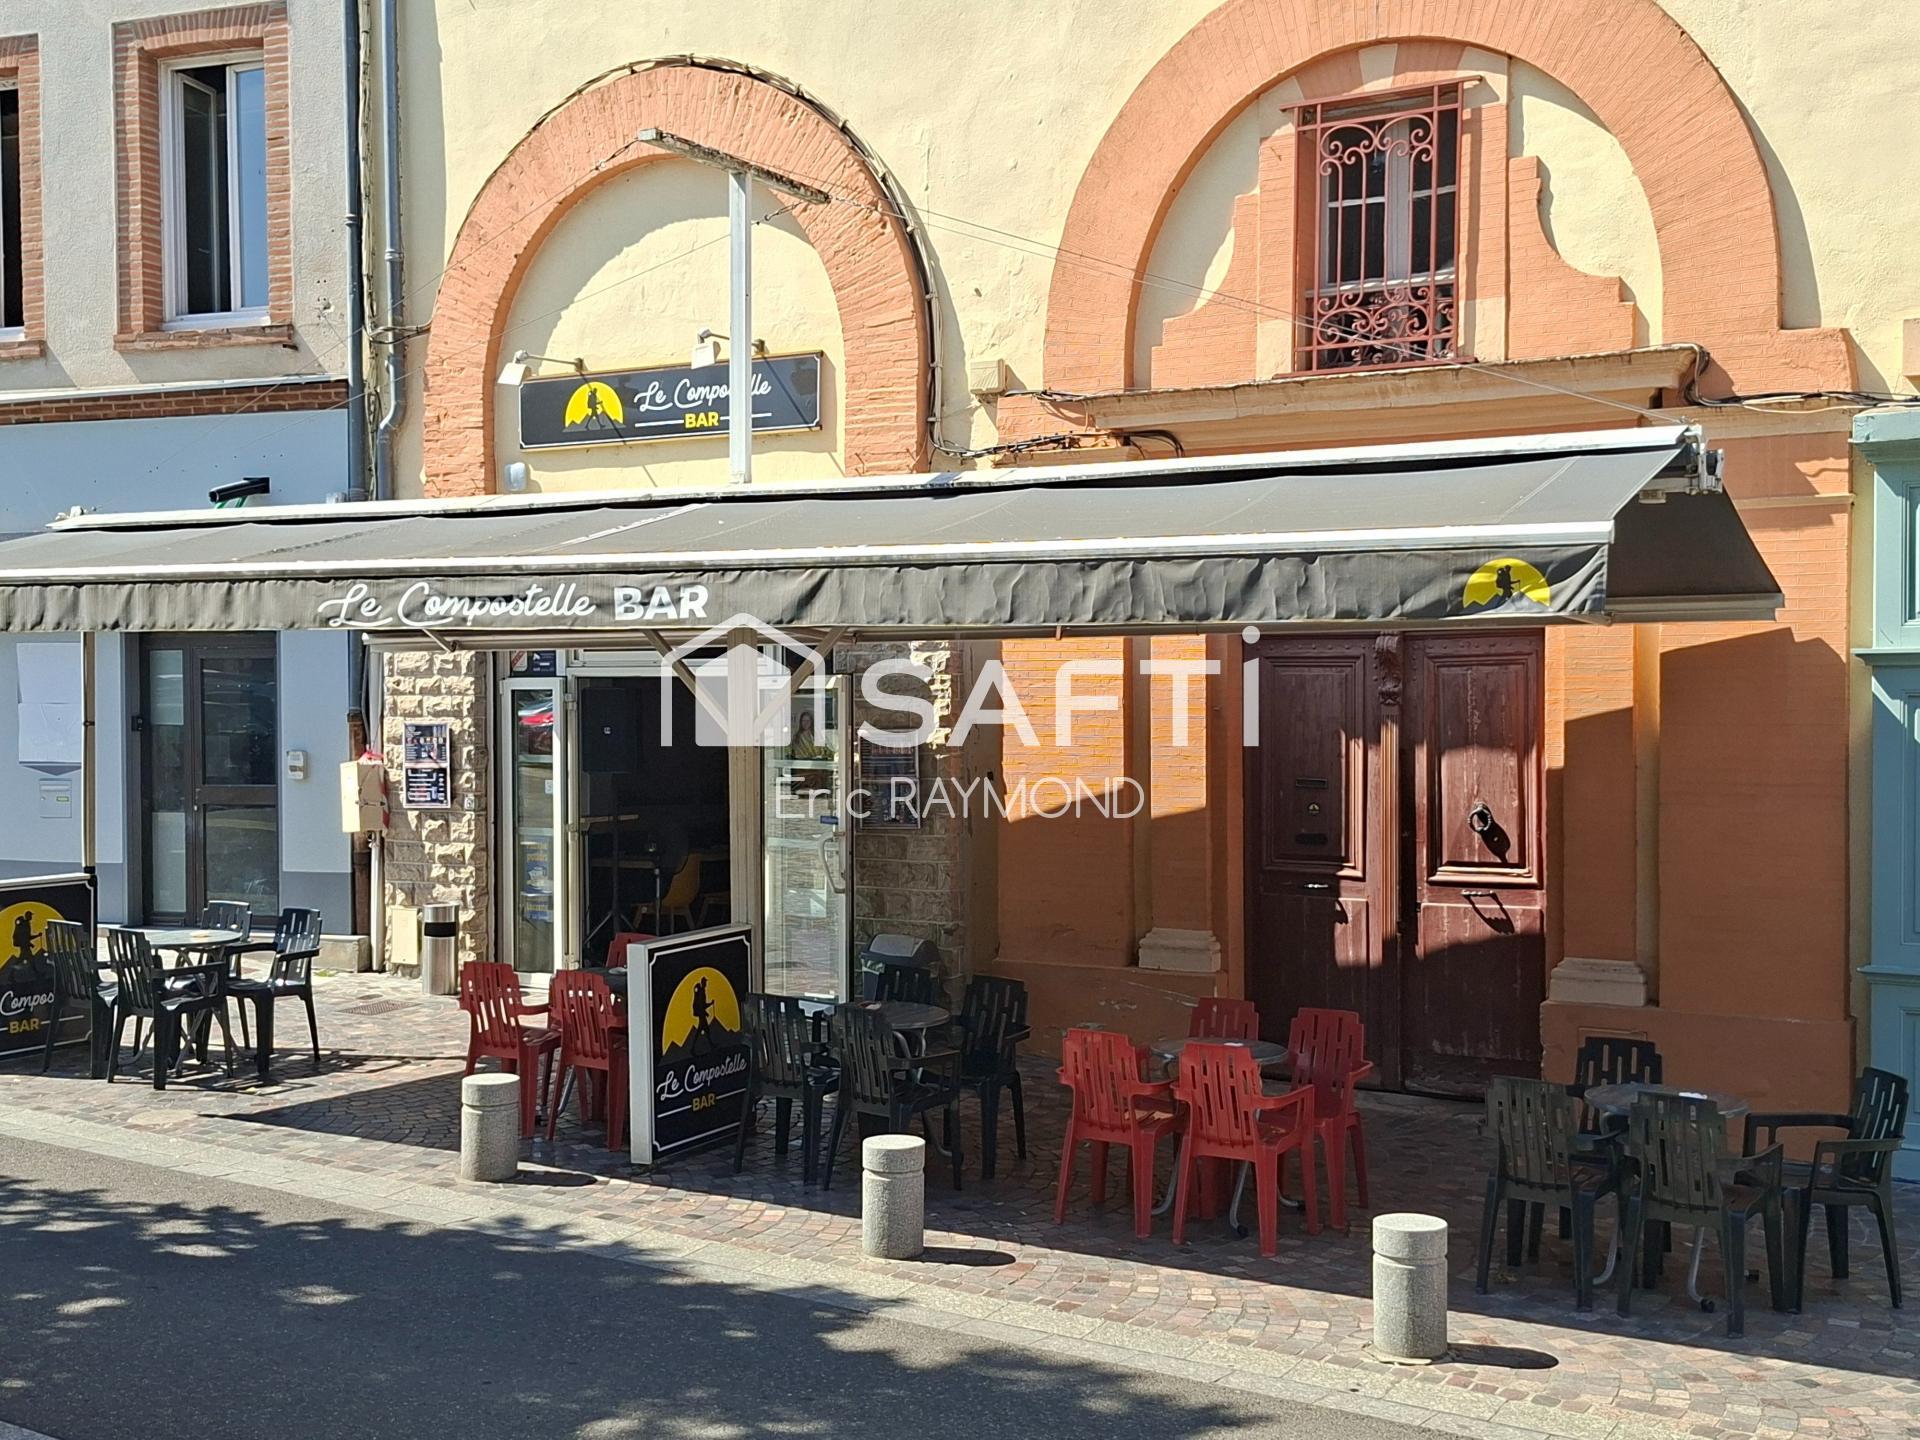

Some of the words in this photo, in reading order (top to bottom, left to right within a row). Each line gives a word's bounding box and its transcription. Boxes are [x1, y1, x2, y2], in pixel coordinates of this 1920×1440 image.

[634, 381, 673, 412] Le
[674, 373, 772, 408] Compolle
[684, 411, 719, 428] BAR
[318, 584, 393, 626] Le
[397, 582, 597, 627] Compostelle
[613, 585, 709, 621] BAR
[0, 990, 55, 1016] Compos
[9, 1018, 40, 1034] BAR
[656, 1070, 684, 1101] Le
[684, 1053, 747, 1092] Compostelle
[692, 1093, 716, 1112] BAR
